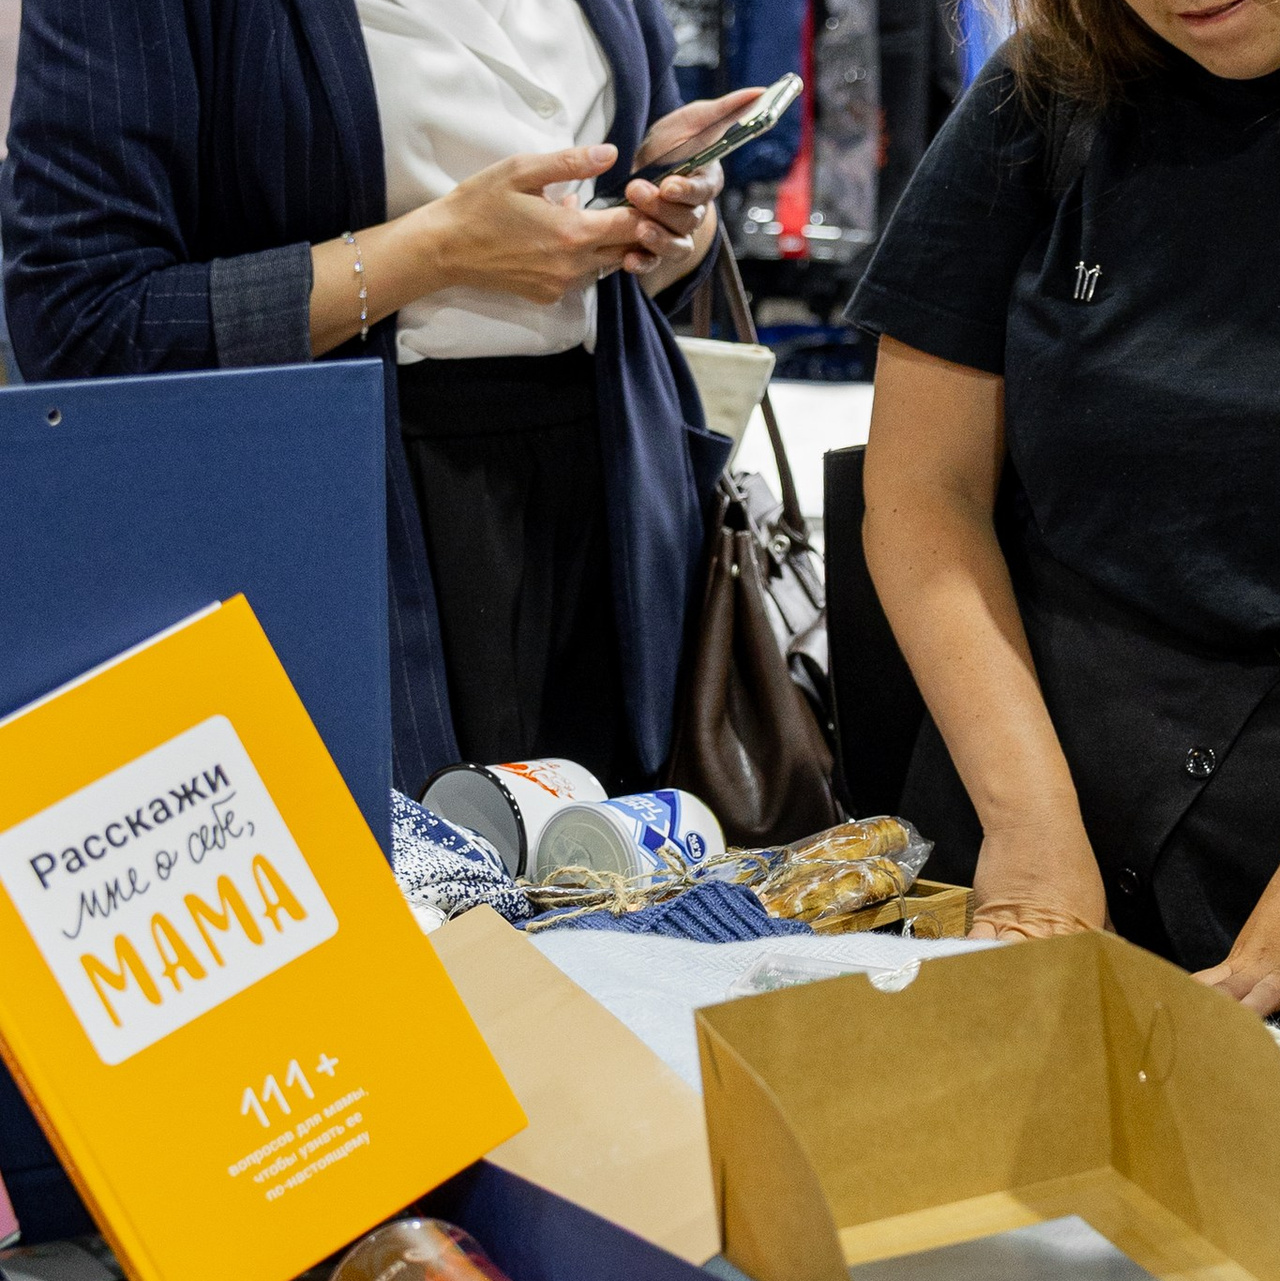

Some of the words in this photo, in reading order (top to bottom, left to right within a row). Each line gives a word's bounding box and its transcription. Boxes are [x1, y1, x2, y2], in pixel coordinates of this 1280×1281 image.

[28, 763, 231, 891] Расскажи
[62, 867, 151, 940] мне
[155, 849, 179, 881] о
[188, 790, 256, 865] себе,
[79, 853, 308, 1029] МАМА
[227, 1130, 295, 1178] вопросов
[296, 1113, 323, 1138] для
[253, 1152, 298, 1183] чтобы
[299, 1125, 345, 1160] узнать
[345, 1111, 363, 1128] ее
[265, 1131, 371, 1202] по-настоящему
